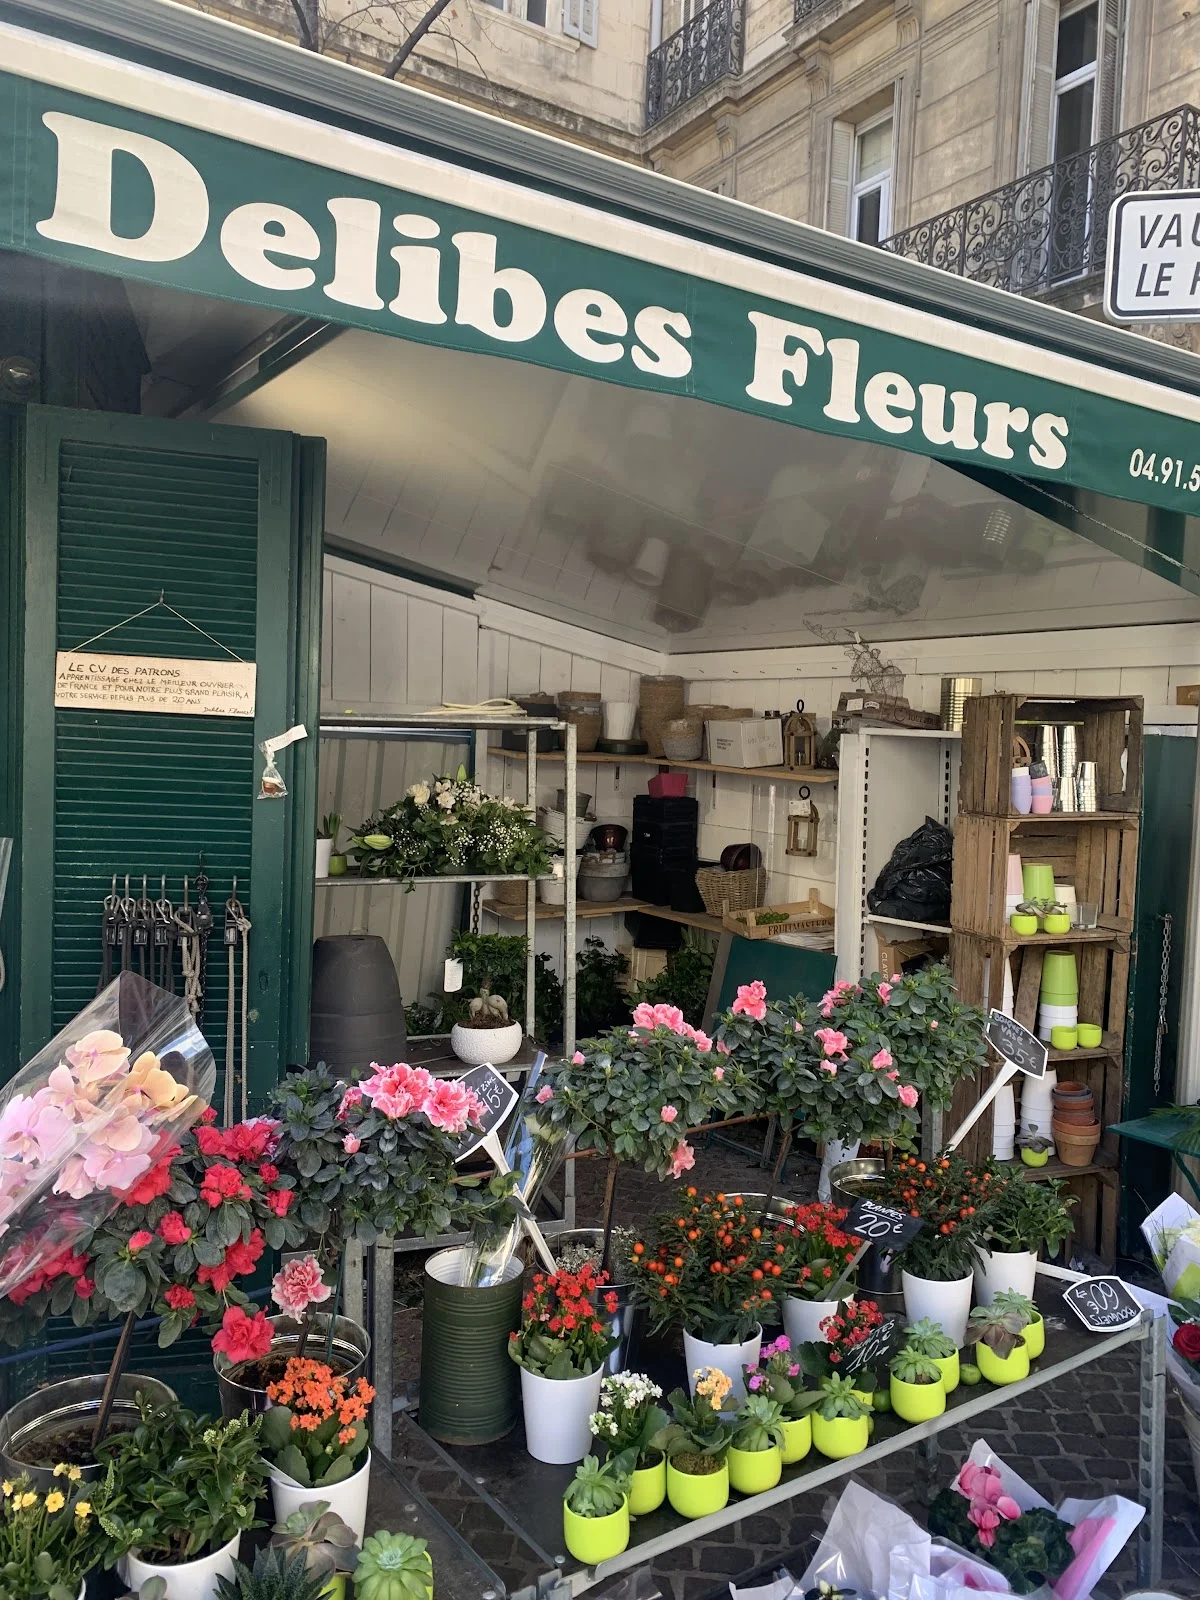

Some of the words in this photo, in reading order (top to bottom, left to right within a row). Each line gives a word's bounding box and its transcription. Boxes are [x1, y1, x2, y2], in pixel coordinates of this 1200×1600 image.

[36, 111, 692, 378] Delibes
[745, 310, 1069, 470] Fleurs
[1135, 262, 1175, 297] LE
[1129, 448, 1200, 492] 04.91.5
[59, 672, 120, 683] APPRENTISSAGE
[160, 679, 197, 687] MEILLEUR
[200, 681, 234, 689] OUVRIER
[68, 662, 84, 672] LE
[89, 664, 107, 673] CV
[111, 666, 129, 675] DES
[135, 667, 180, 677] PATRONS
[69, 682, 98, 690] FRANCE
[115, 684, 135, 692] POUR
[881, 952, 889, 981] CLAYR
[1089, 1305, 1137, 1326] BOUQUETS
